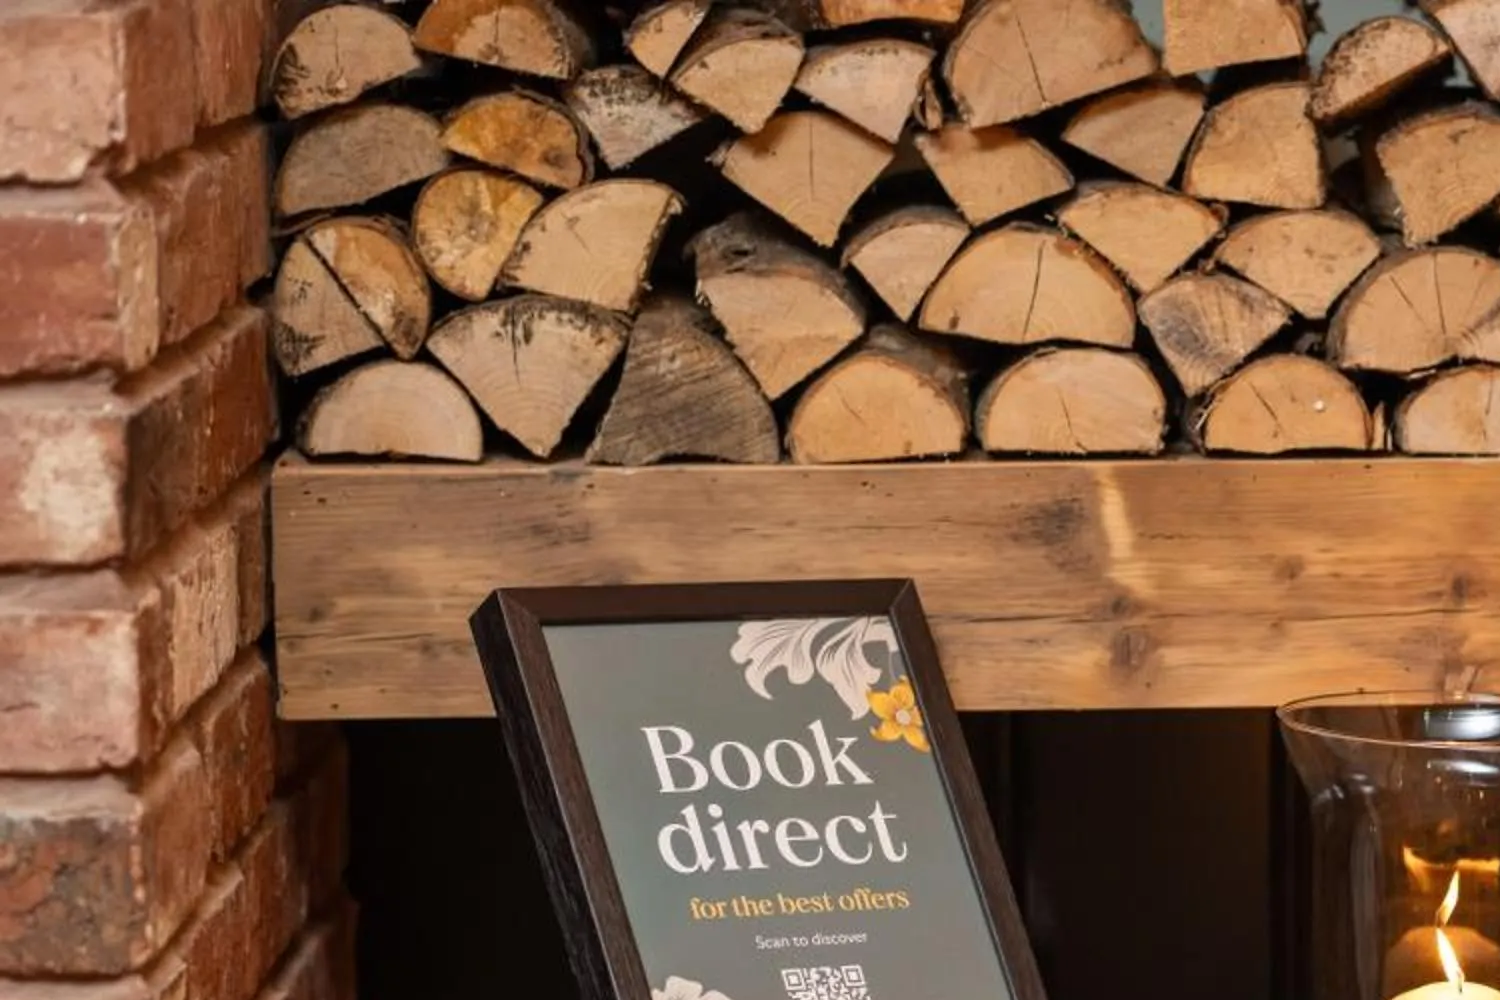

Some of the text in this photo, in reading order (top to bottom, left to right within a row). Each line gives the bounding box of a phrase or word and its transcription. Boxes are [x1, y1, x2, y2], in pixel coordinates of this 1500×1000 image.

[640, 719, 874, 793] Book
[657, 800, 907, 874] direct
[689, 887, 911, 920] for the best offers
[754, 930, 869, 950] Scan to discover
